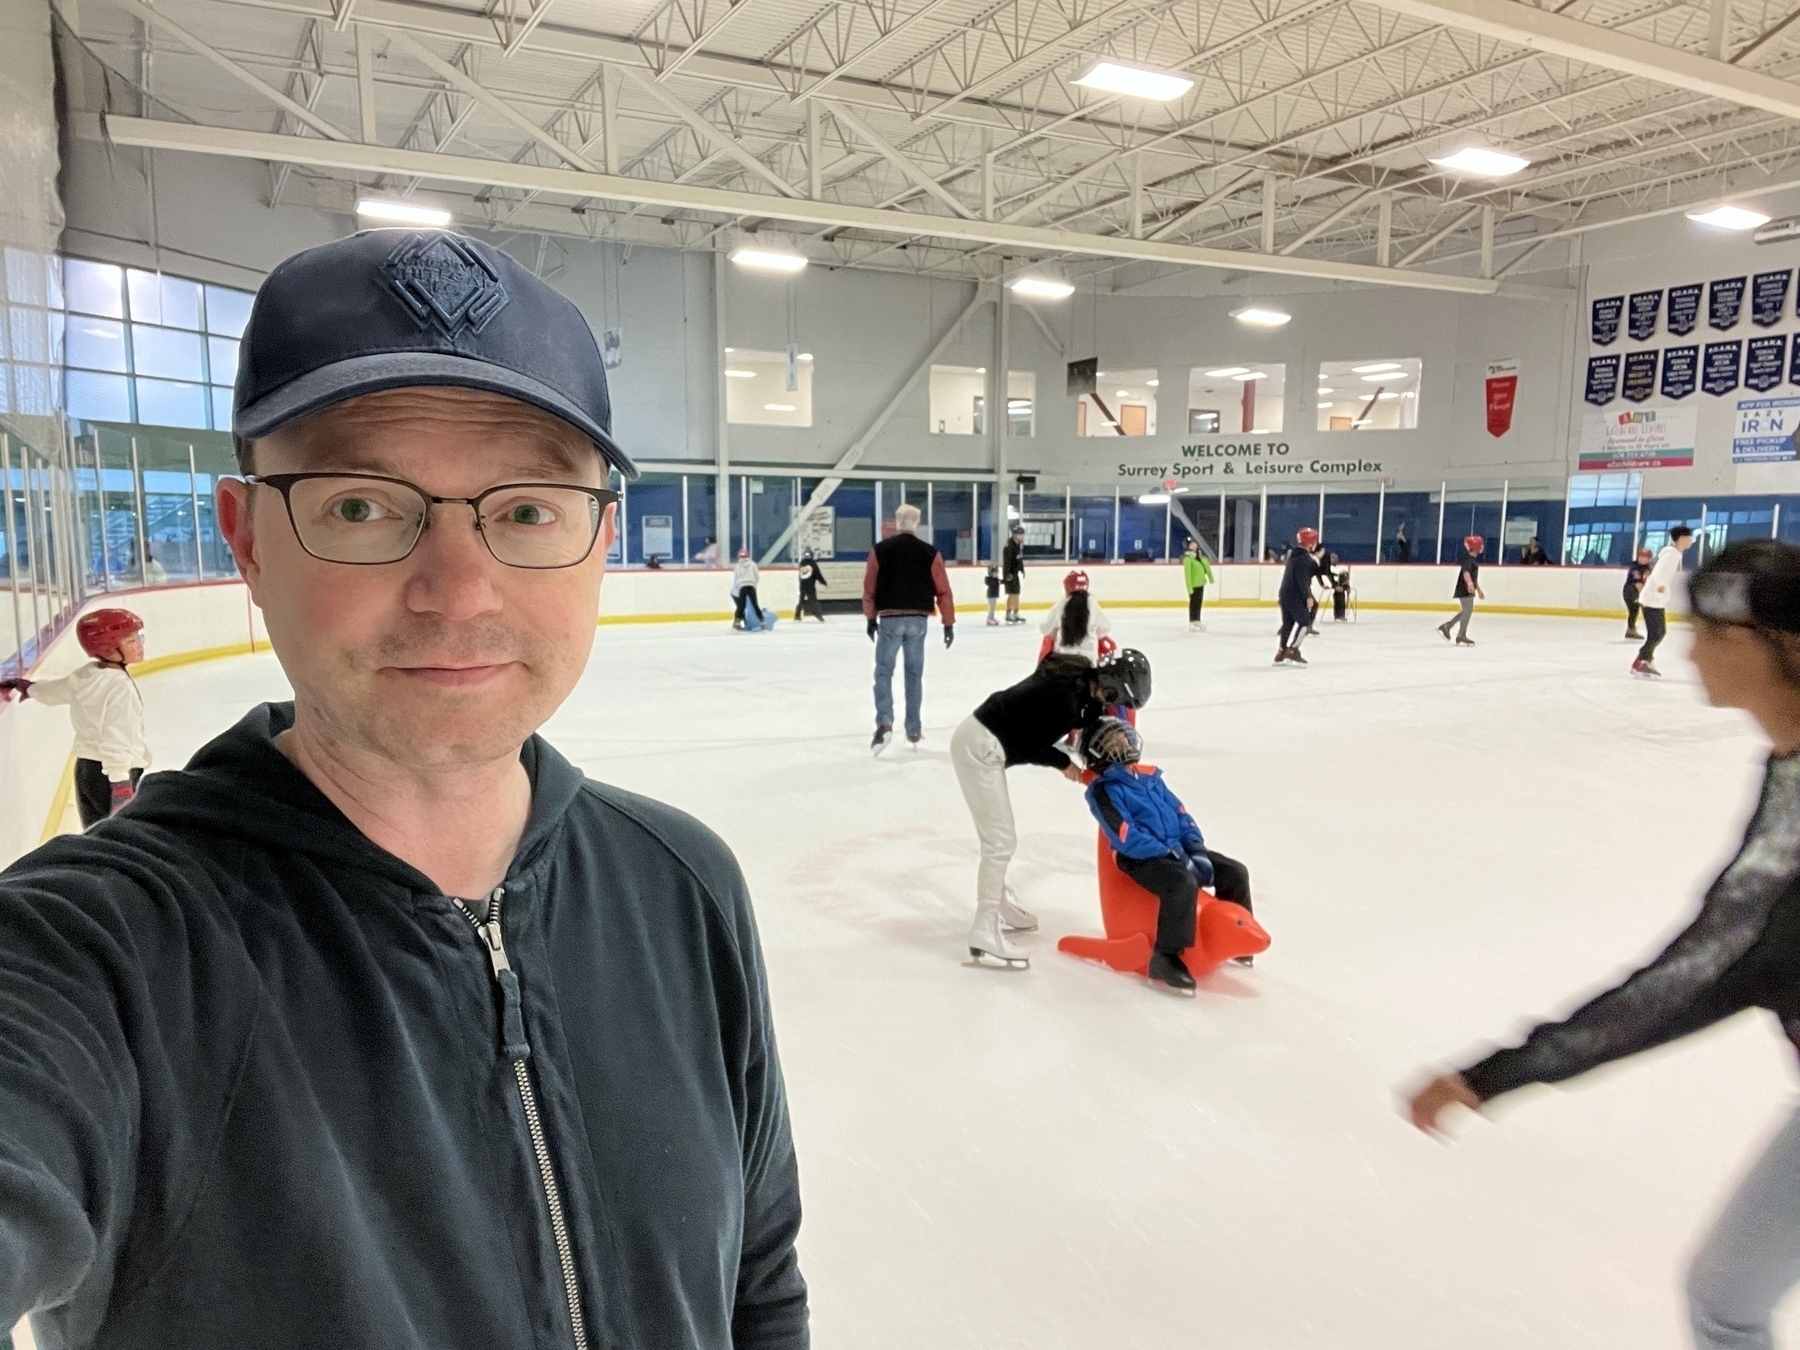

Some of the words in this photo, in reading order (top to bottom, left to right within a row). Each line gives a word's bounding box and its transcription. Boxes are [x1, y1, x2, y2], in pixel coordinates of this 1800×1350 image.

[1181, 443, 1261, 457] WELCOME
[1267, 443, 1289, 456] TO
[1118, 464, 1168, 479] Surrey
[1172, 463, 1214, 478] Sport
[1223, 462, 1235, 475] &
[1245, 461, 1303, 474] Leisure
[1309, 459, 1382, 475] Complex
